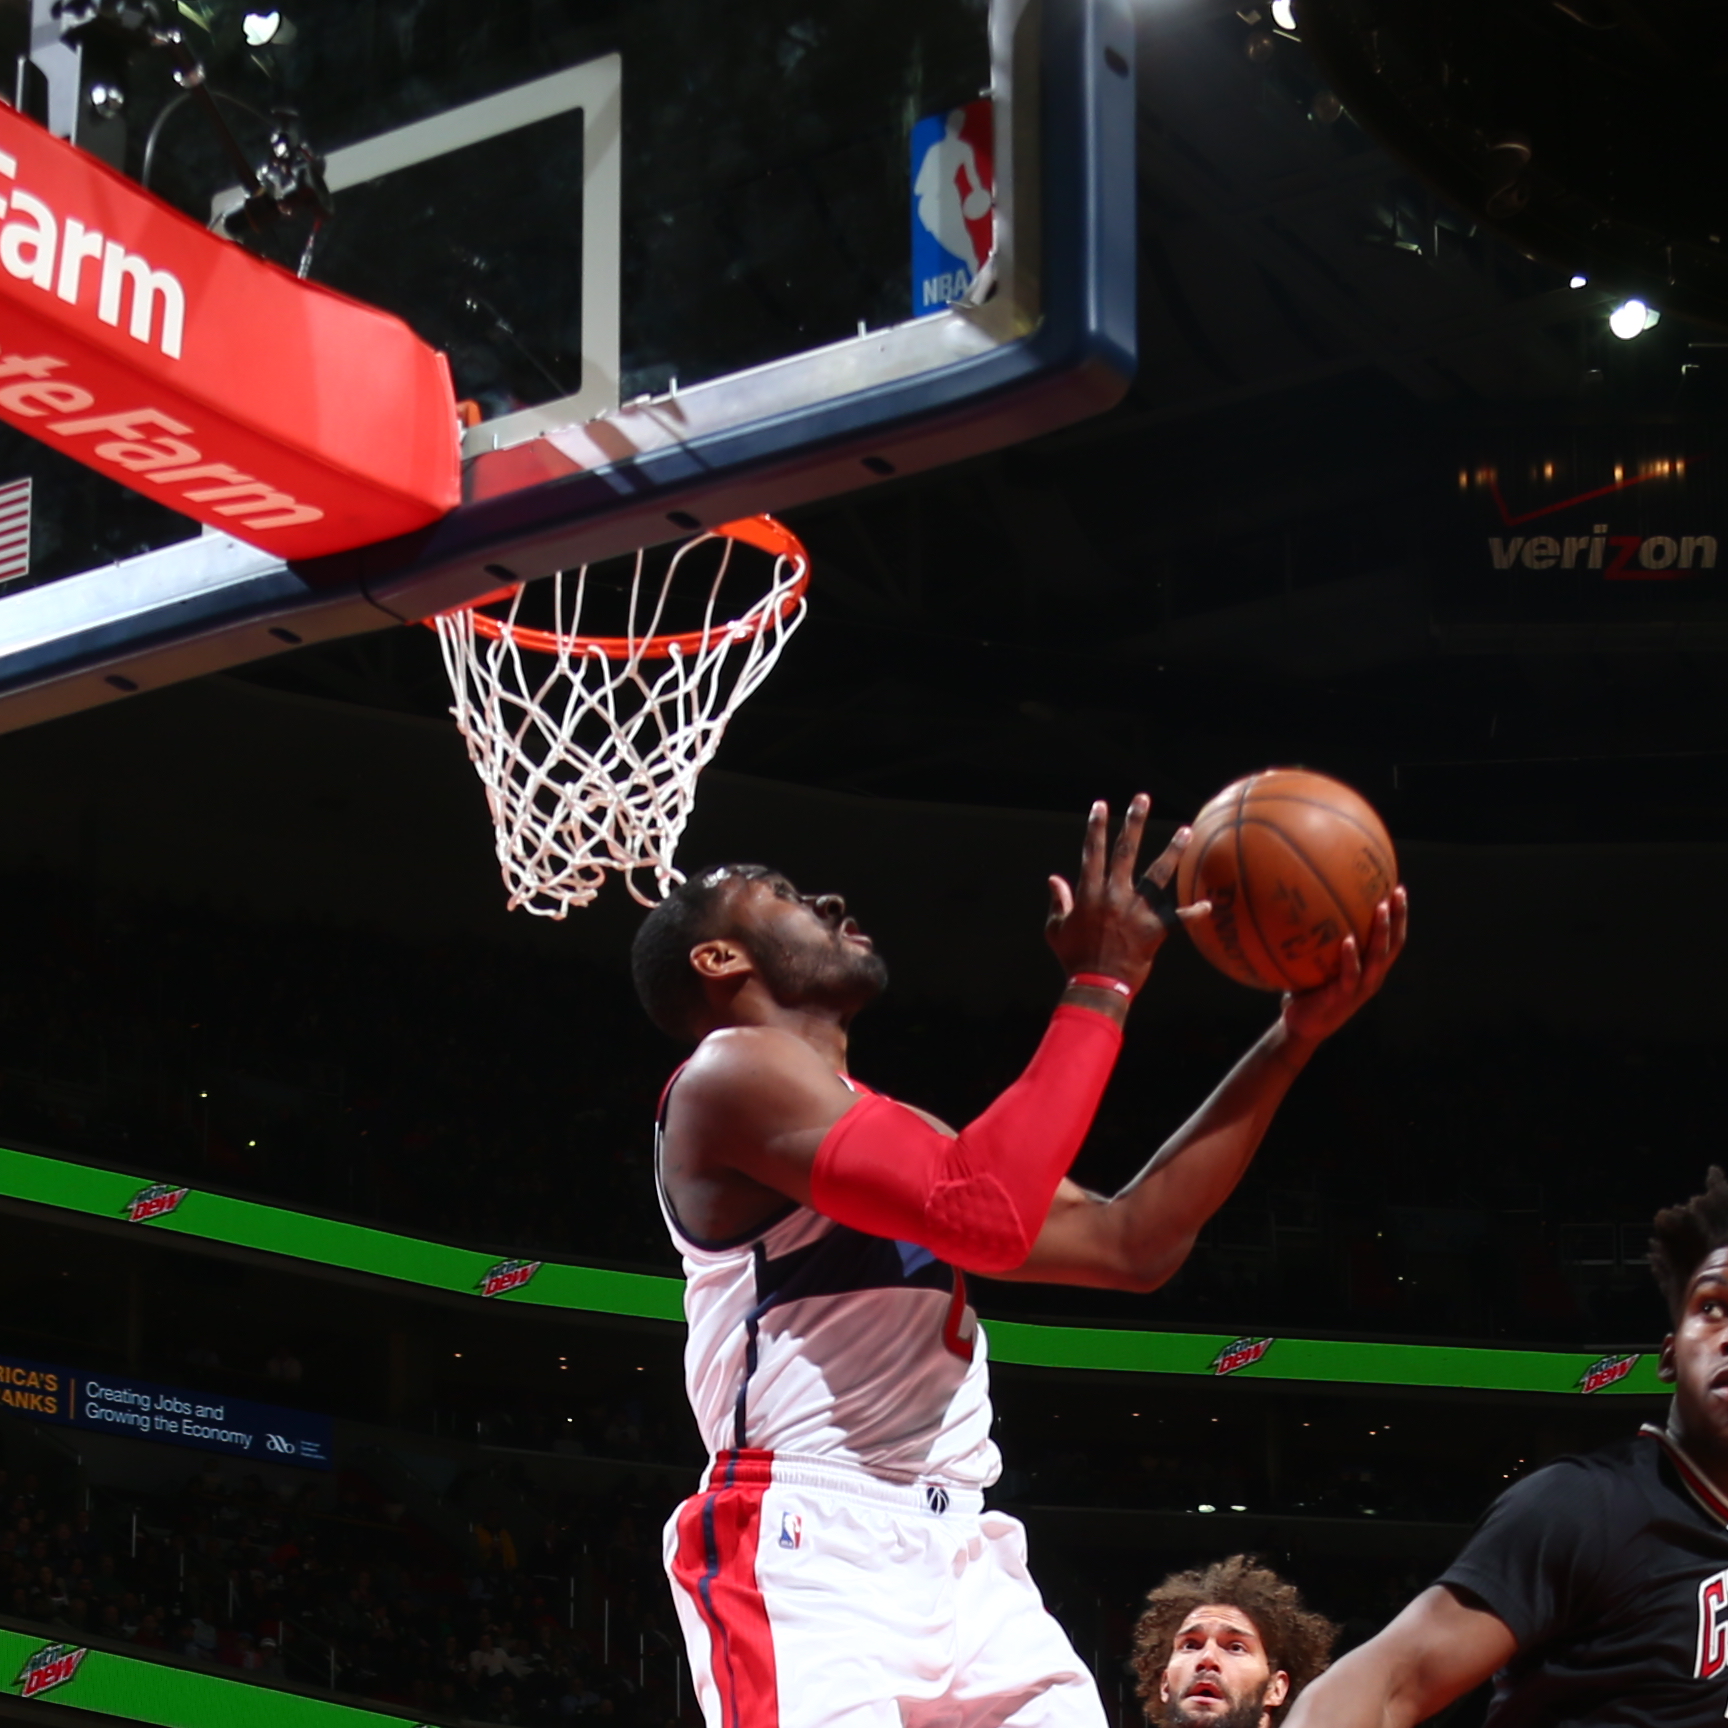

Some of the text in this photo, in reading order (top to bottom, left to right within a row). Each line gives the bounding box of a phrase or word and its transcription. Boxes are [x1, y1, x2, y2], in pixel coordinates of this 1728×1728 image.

[922, 269, 970, 306] NBA
[1488, 523, 1719, 580] verizon
[85, 1381, 224, 1421] Creating Jobs and
[85, 1402, 253, 1450] Growing the Economy
